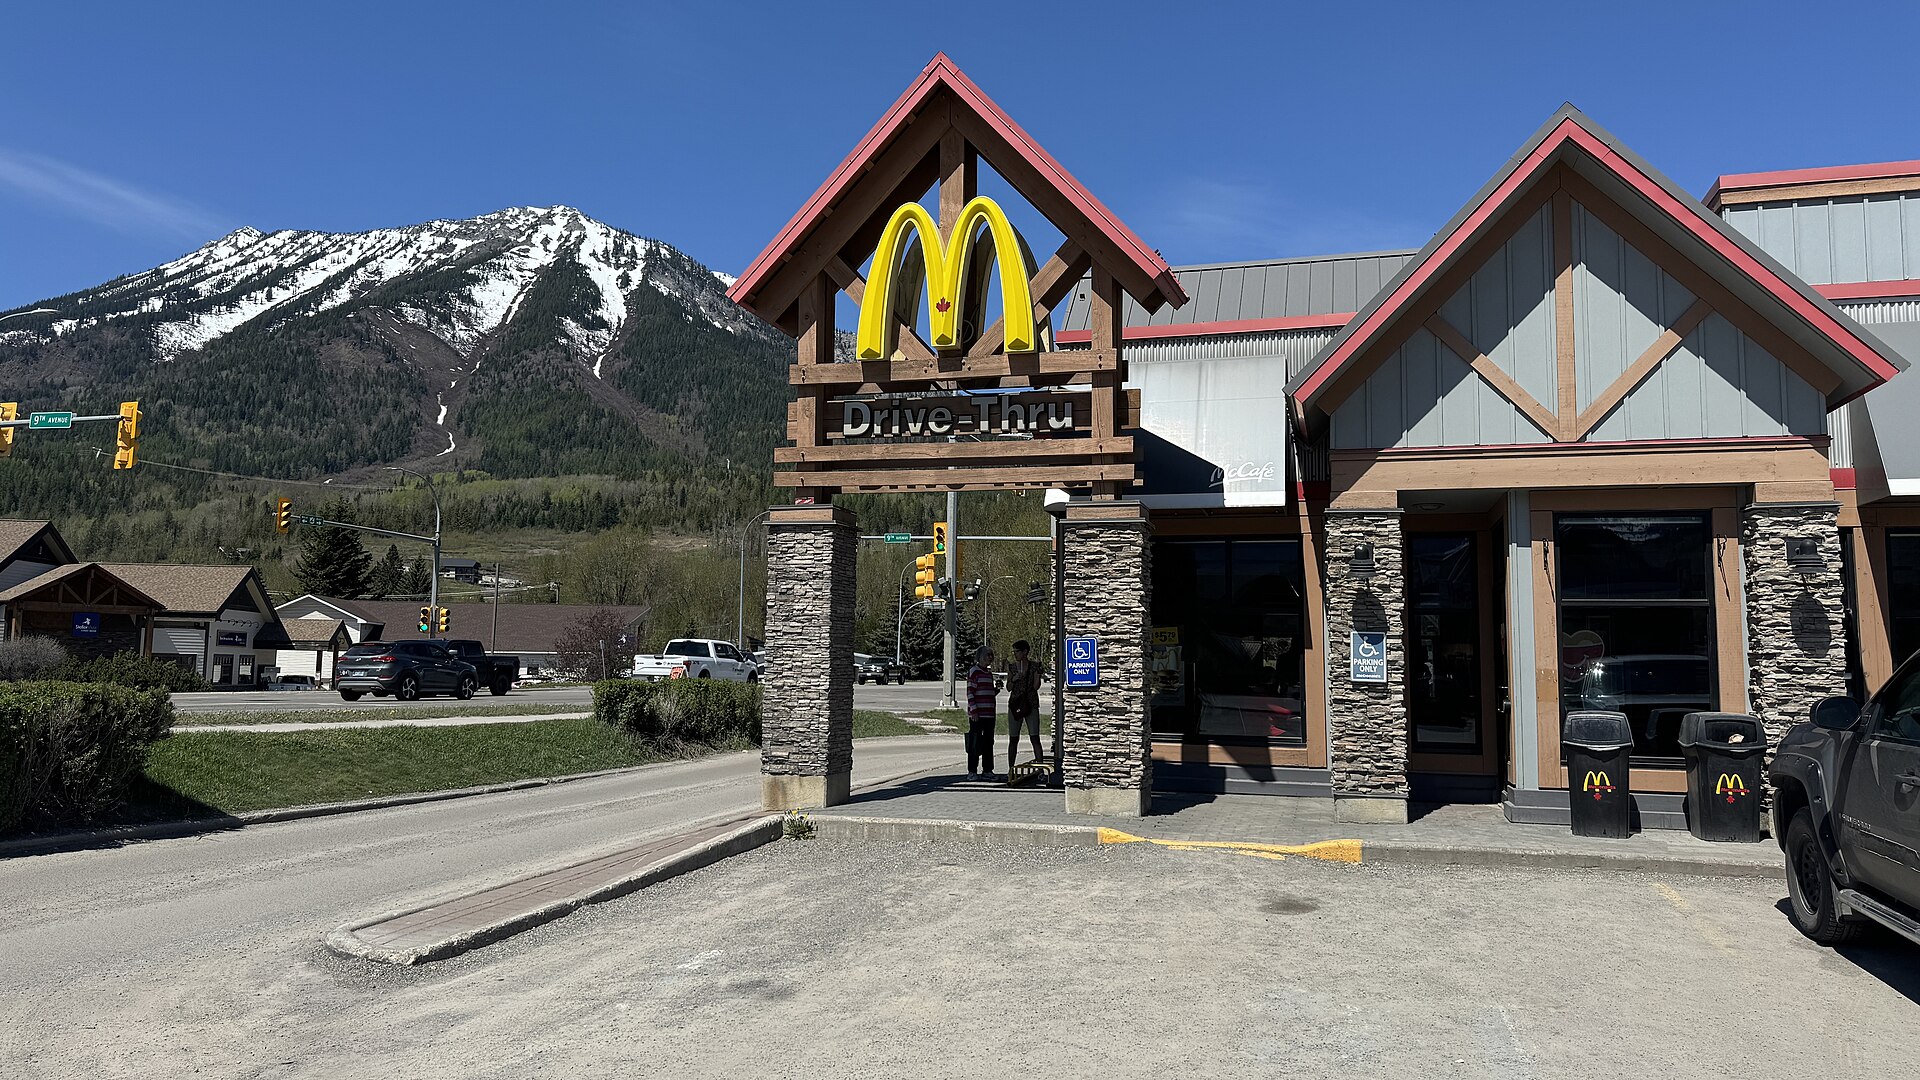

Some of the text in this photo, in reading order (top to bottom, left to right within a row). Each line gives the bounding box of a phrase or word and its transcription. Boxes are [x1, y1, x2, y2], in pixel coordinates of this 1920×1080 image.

[843, 395, 1074, 436] Drive-Thru
[48, 416, 69, 424] AVENUE
[1209, 461, 1275, 488] McCafé
[1353, 658, 1384, 666] PARKING
[1359, 665, 1378, 673] ONLY
